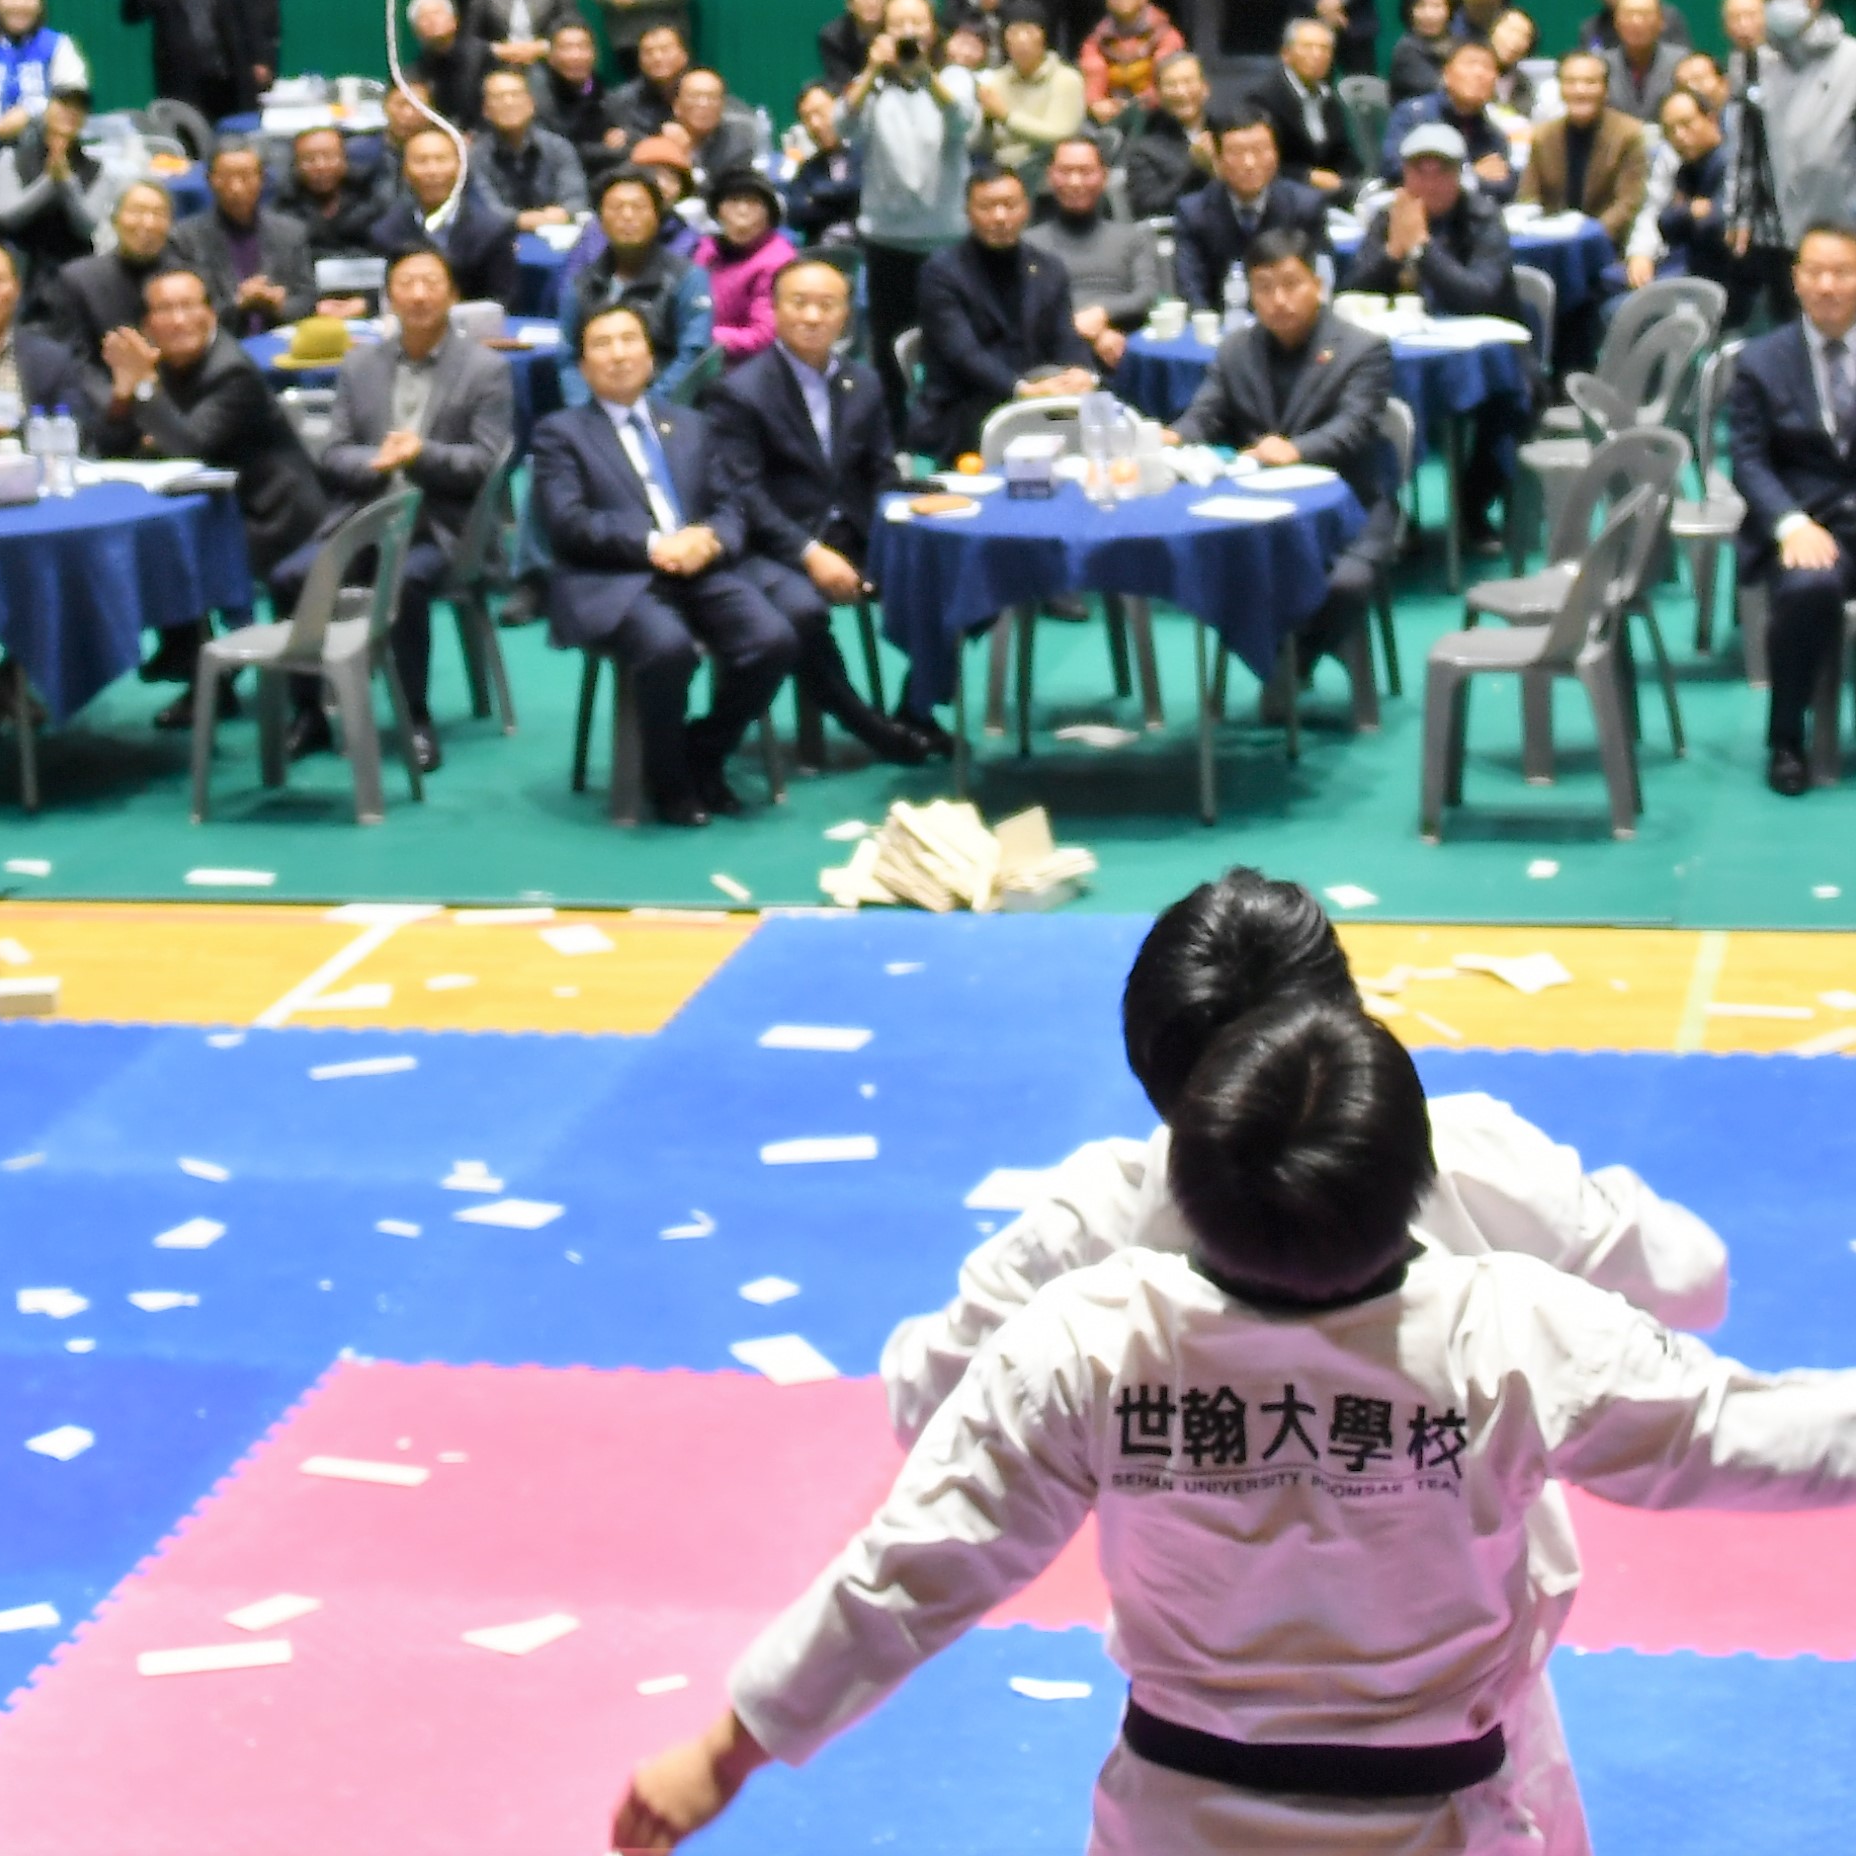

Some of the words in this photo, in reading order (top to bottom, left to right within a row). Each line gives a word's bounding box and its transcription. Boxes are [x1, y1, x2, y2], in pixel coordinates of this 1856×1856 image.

[1114, 1383, 1468, 1479] 世翰大學校
[1112, 1472, 1174, 1491] SEHAN
[1183, 1471, 1300, 1494] UNIVERSITY
